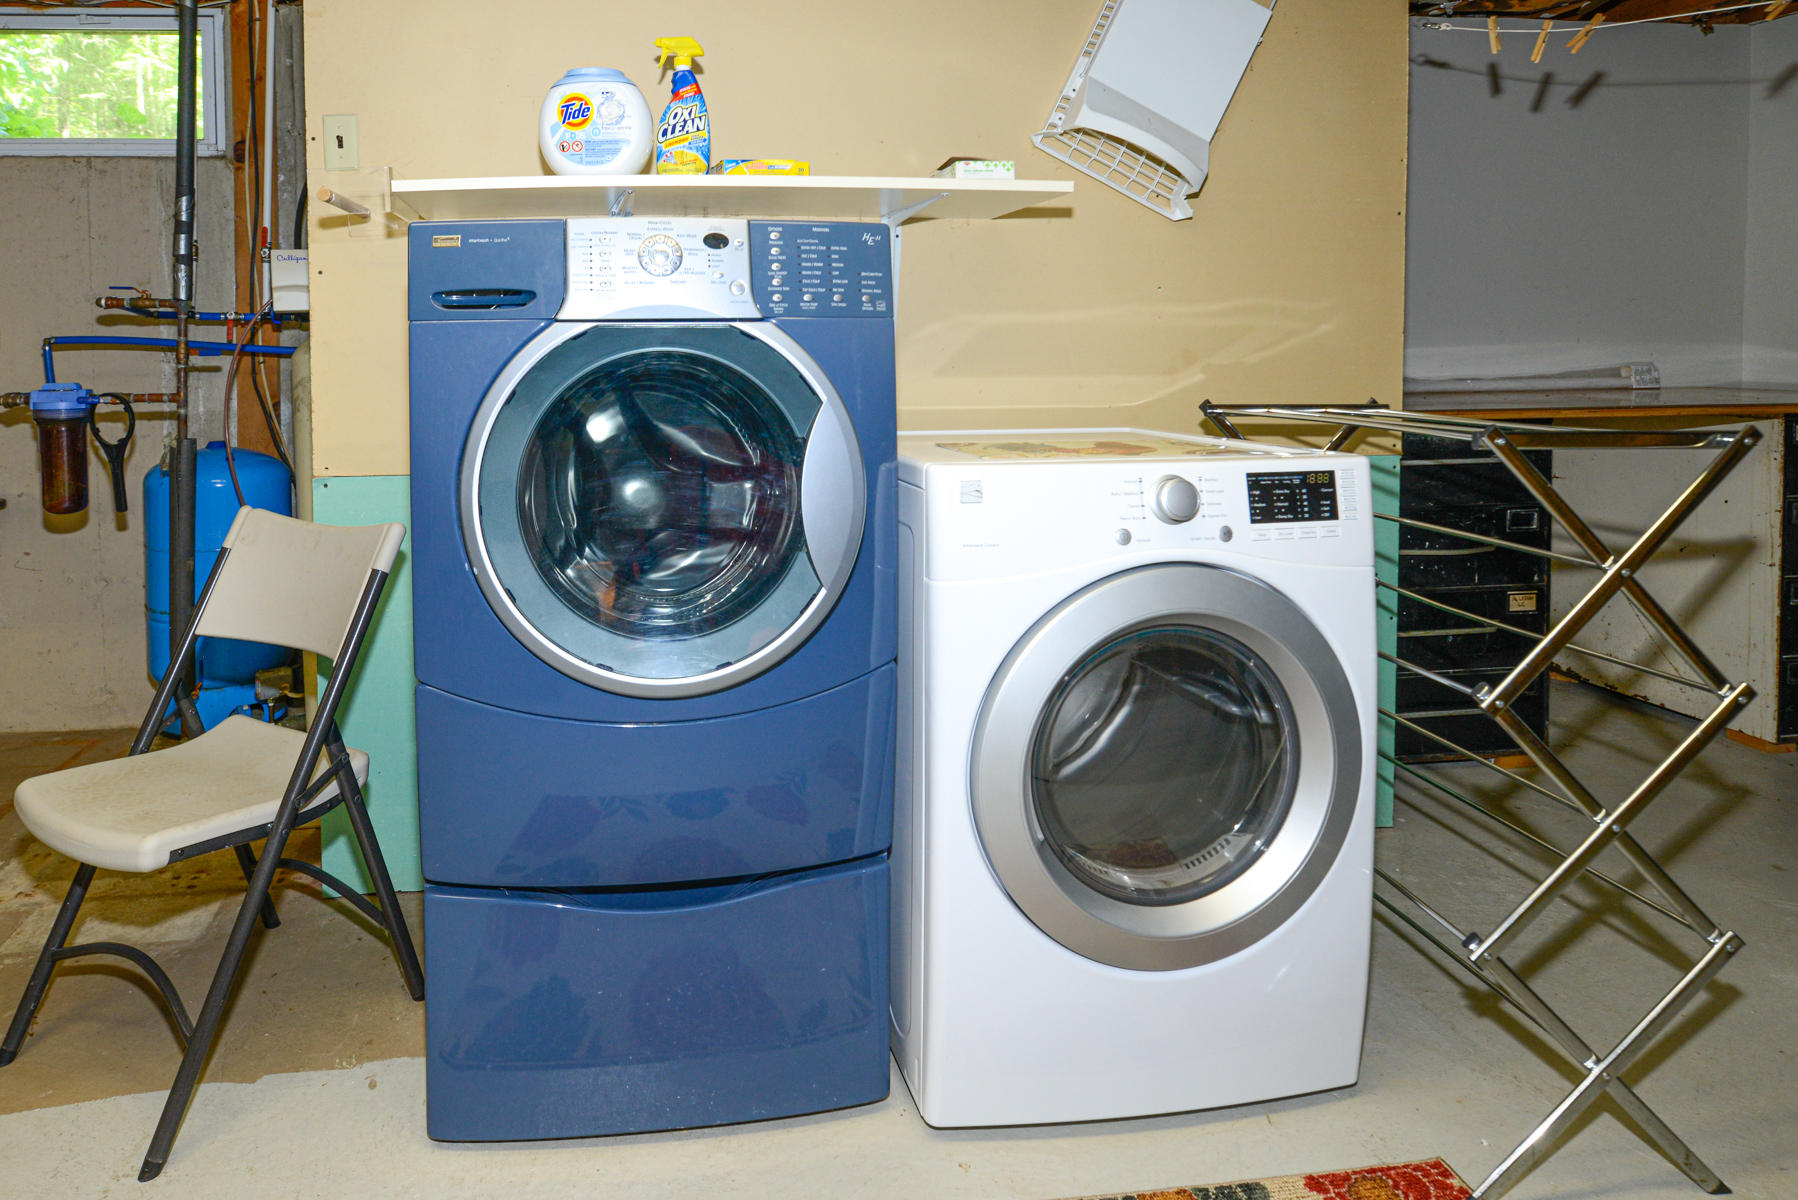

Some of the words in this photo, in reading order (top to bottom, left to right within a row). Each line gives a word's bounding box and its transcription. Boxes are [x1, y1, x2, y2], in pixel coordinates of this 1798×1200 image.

[561, 102, 591, 125] Tide
[668, 105, 697, 125] OXI
[658, 116, 706, 143] CLEAN
